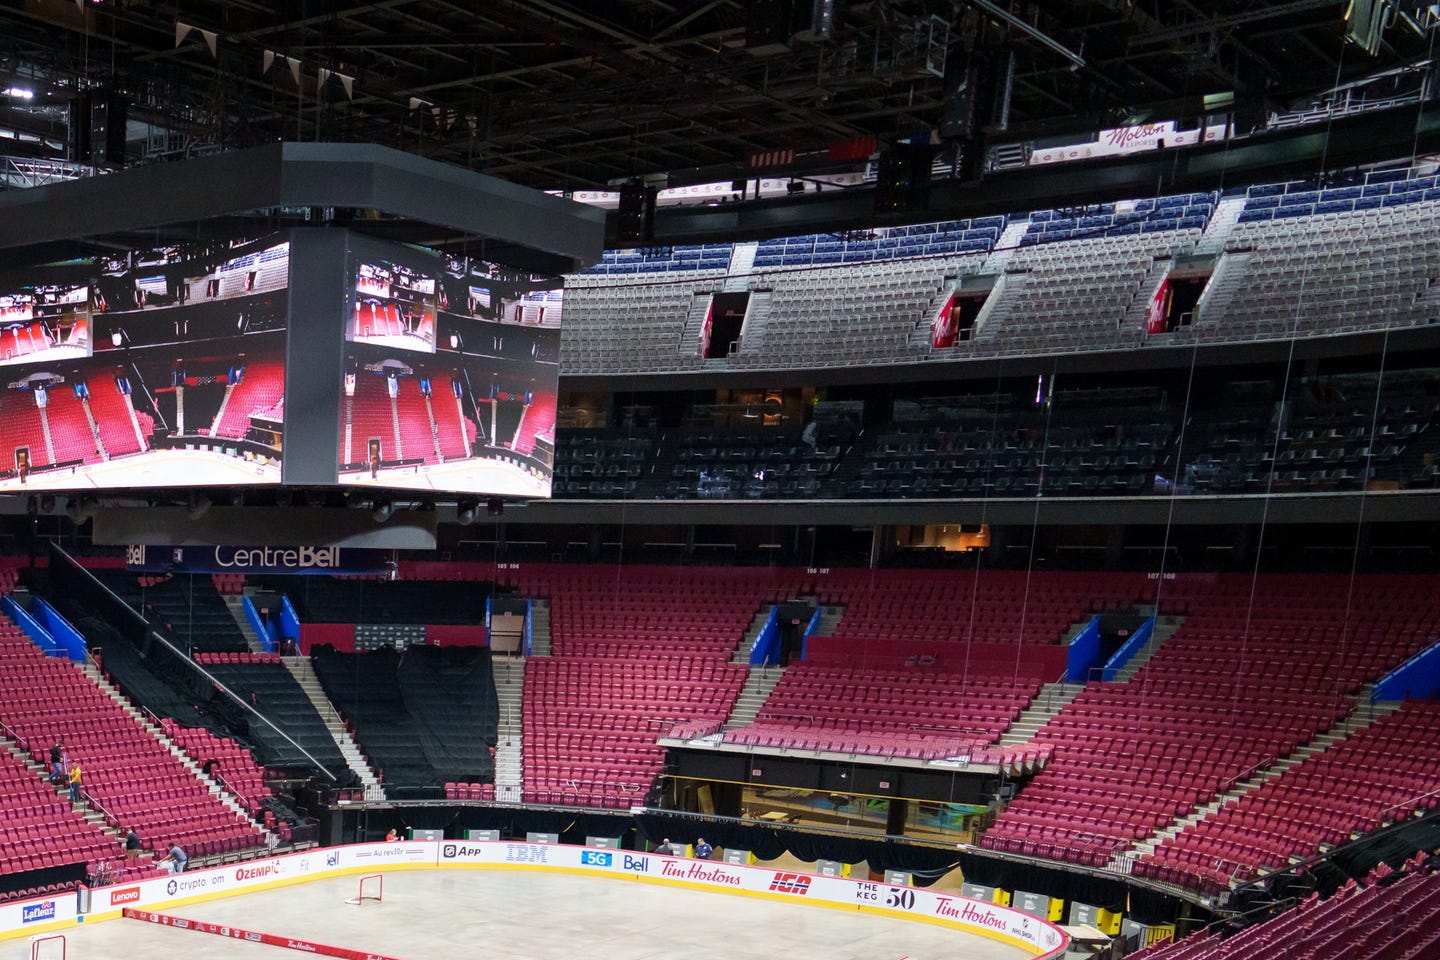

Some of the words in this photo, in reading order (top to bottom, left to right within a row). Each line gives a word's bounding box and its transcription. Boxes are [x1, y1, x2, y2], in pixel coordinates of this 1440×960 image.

[1106, 123, 1164, 147] Molson
[1147, 571, 1160, 579] 107
[506, 845, 548, 862] IBM
[587, 853, 607, 865] 5G
[624, 854, 648, 872] Bell
[662, 860, 686, 880] Tim
[687, 863, 742, 885] Hortons
[768, 872, 812, 894] IGA
[857, 883, 878, 891] THE
[113, 891, 139, 903] Lenovo
[857, 891, 878, 901] KEG
[886, 887, 916, 910] 50
[23, 903, 54, 920] Lafleur
[936, 897, 960, 919] Tim
[961, 905, 1007, 930] Hortons
